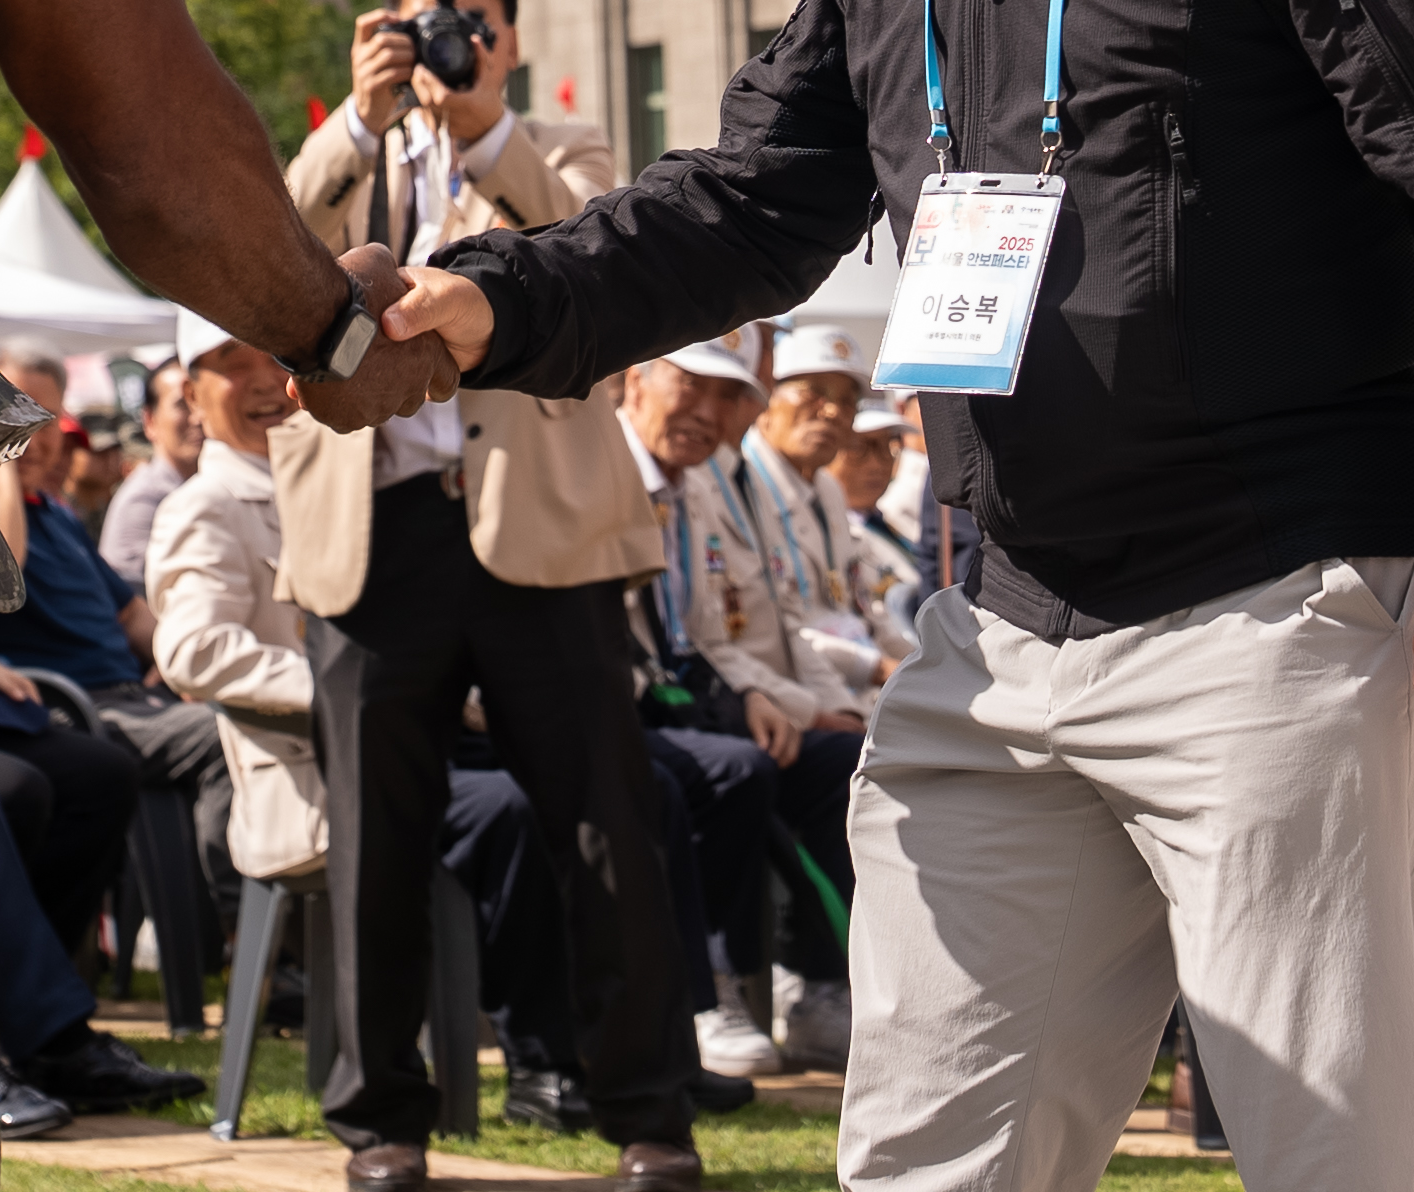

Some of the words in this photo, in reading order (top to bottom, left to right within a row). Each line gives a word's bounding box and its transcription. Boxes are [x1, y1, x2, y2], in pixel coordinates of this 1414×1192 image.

[998, 236, 1035, 251] 2025
[967, 253, 1030, 269] 안보페스타
[922, 294, 998, 324] 이승복
